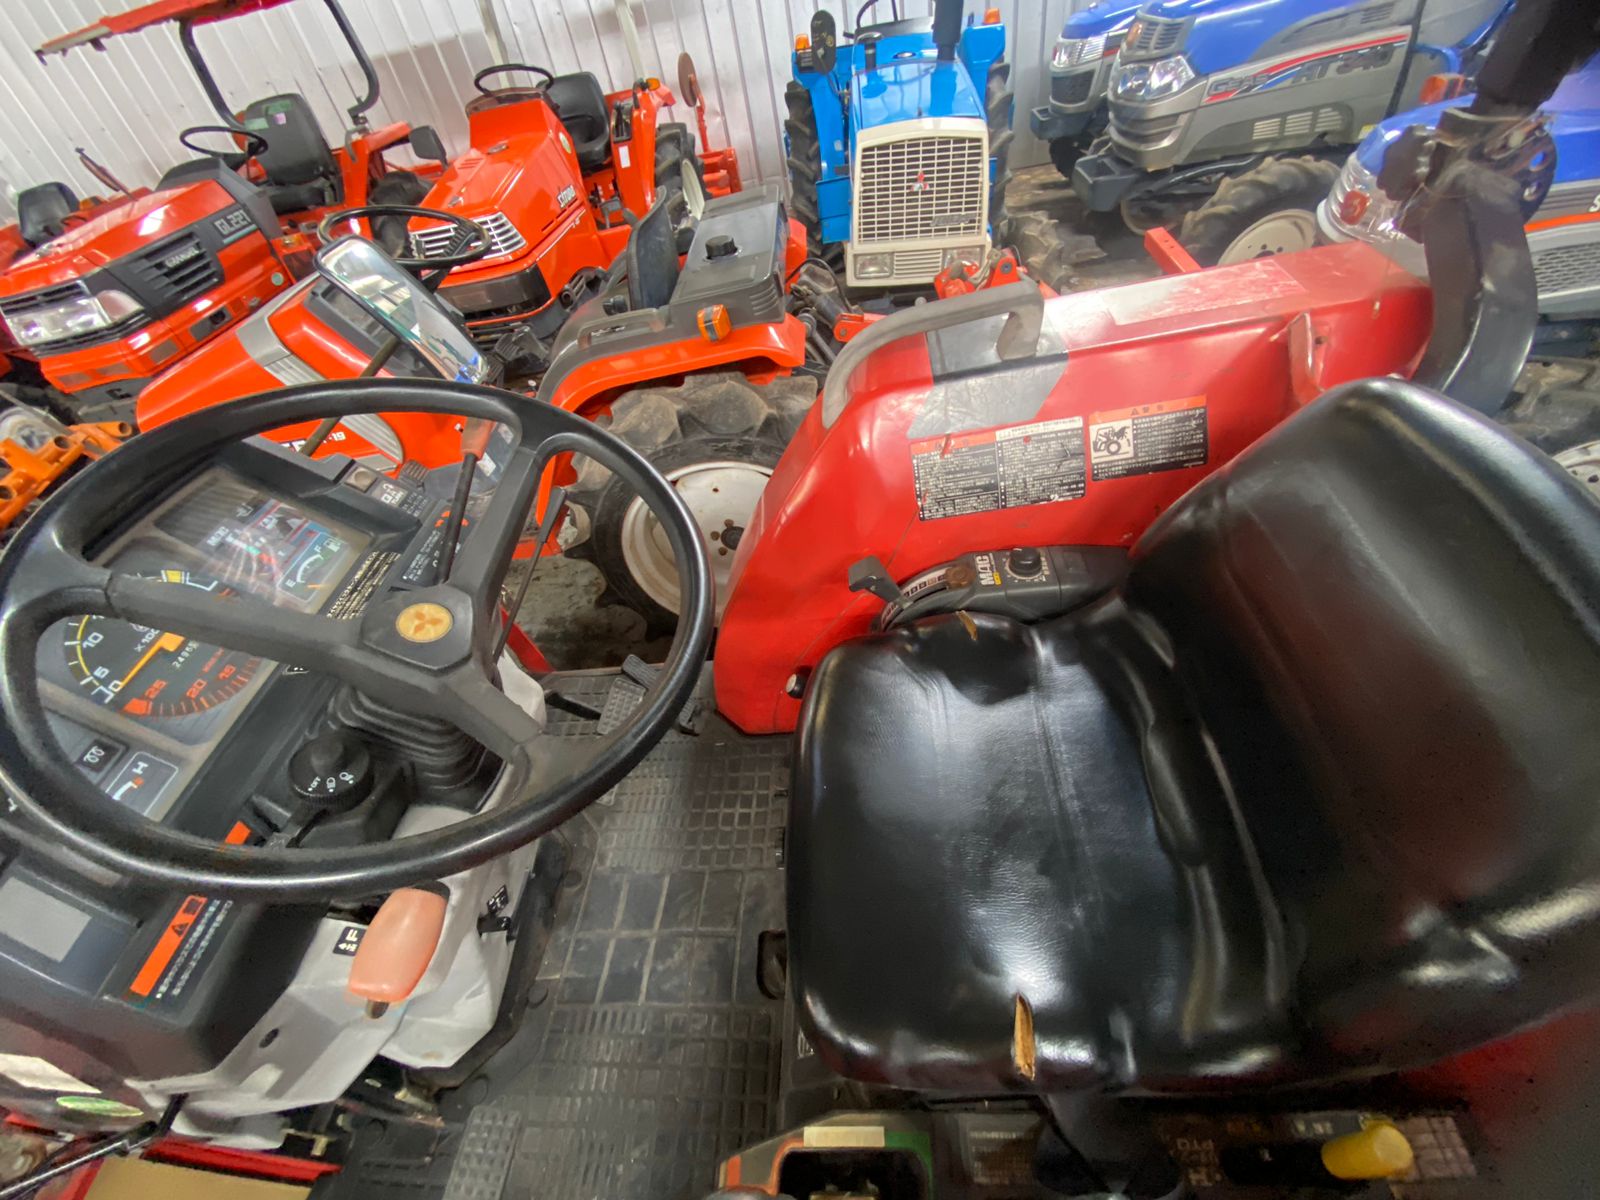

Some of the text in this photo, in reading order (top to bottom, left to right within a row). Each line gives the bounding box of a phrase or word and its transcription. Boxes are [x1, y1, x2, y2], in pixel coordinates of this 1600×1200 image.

[213, 210, 252, 235] GL221
[976, 554, 995, 587] MAC
[83, 631, 104, 649] 10
[93, 666, 110, 679] 5
[145, 679, 167, 699] 25
[186, 678, 207, 699] 20
[132, 761, 149, 774] H
[346, 928, 358, 942] F
